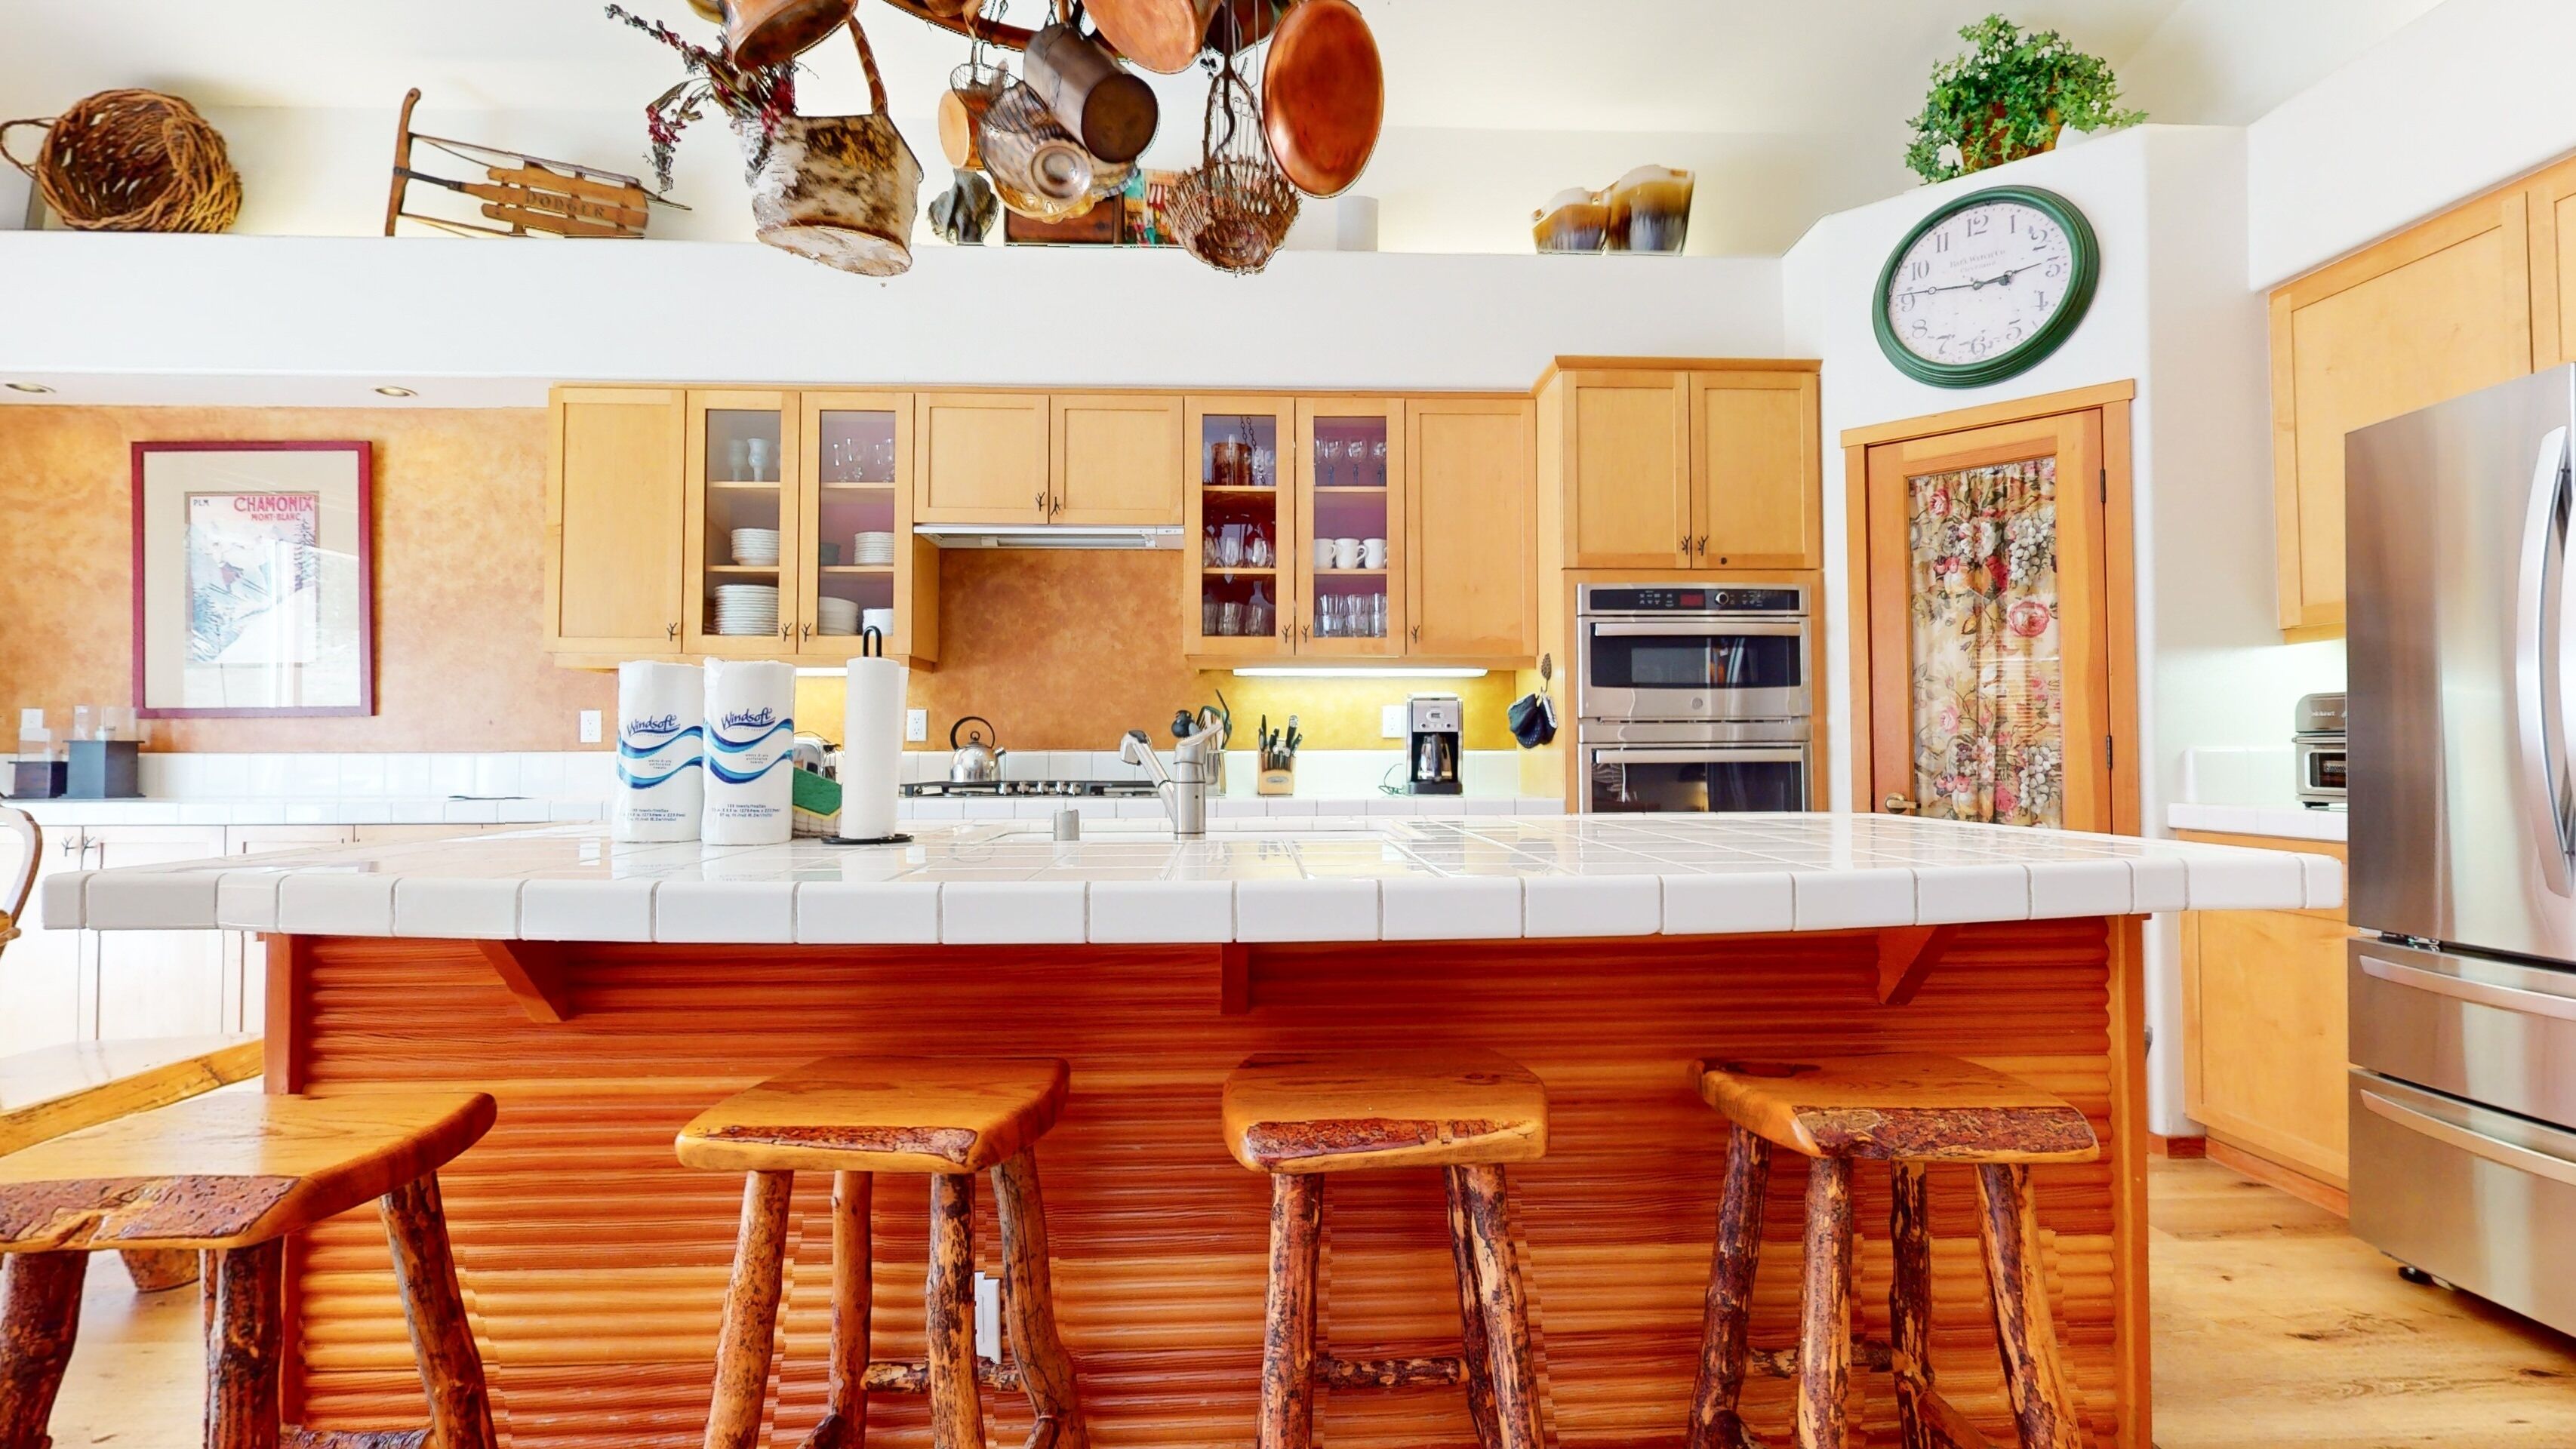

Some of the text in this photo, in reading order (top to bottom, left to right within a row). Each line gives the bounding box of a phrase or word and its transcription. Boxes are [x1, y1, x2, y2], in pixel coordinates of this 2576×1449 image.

[1967, 214, 1989, 238] 12
[2010, 214, 2016, 234] 1
[1936, 232, 1949, 254] 11
[2030, 229, 2048, 251] 2
[1911, 260, 1930, 281] 10
[1900, 289, 1916, 312] 9
[1911, 319, 1928, 340] 8
[2005, 318, 2022, 340] 5
[1936, 334, 1955, 355] 7
[1971, 335, 1987, 355] 6
[233, 496, 313, 512] CHAMONIX
[626, 714, 679, 737] Windsoft
[721, 706, 774, 731] Windsoft
